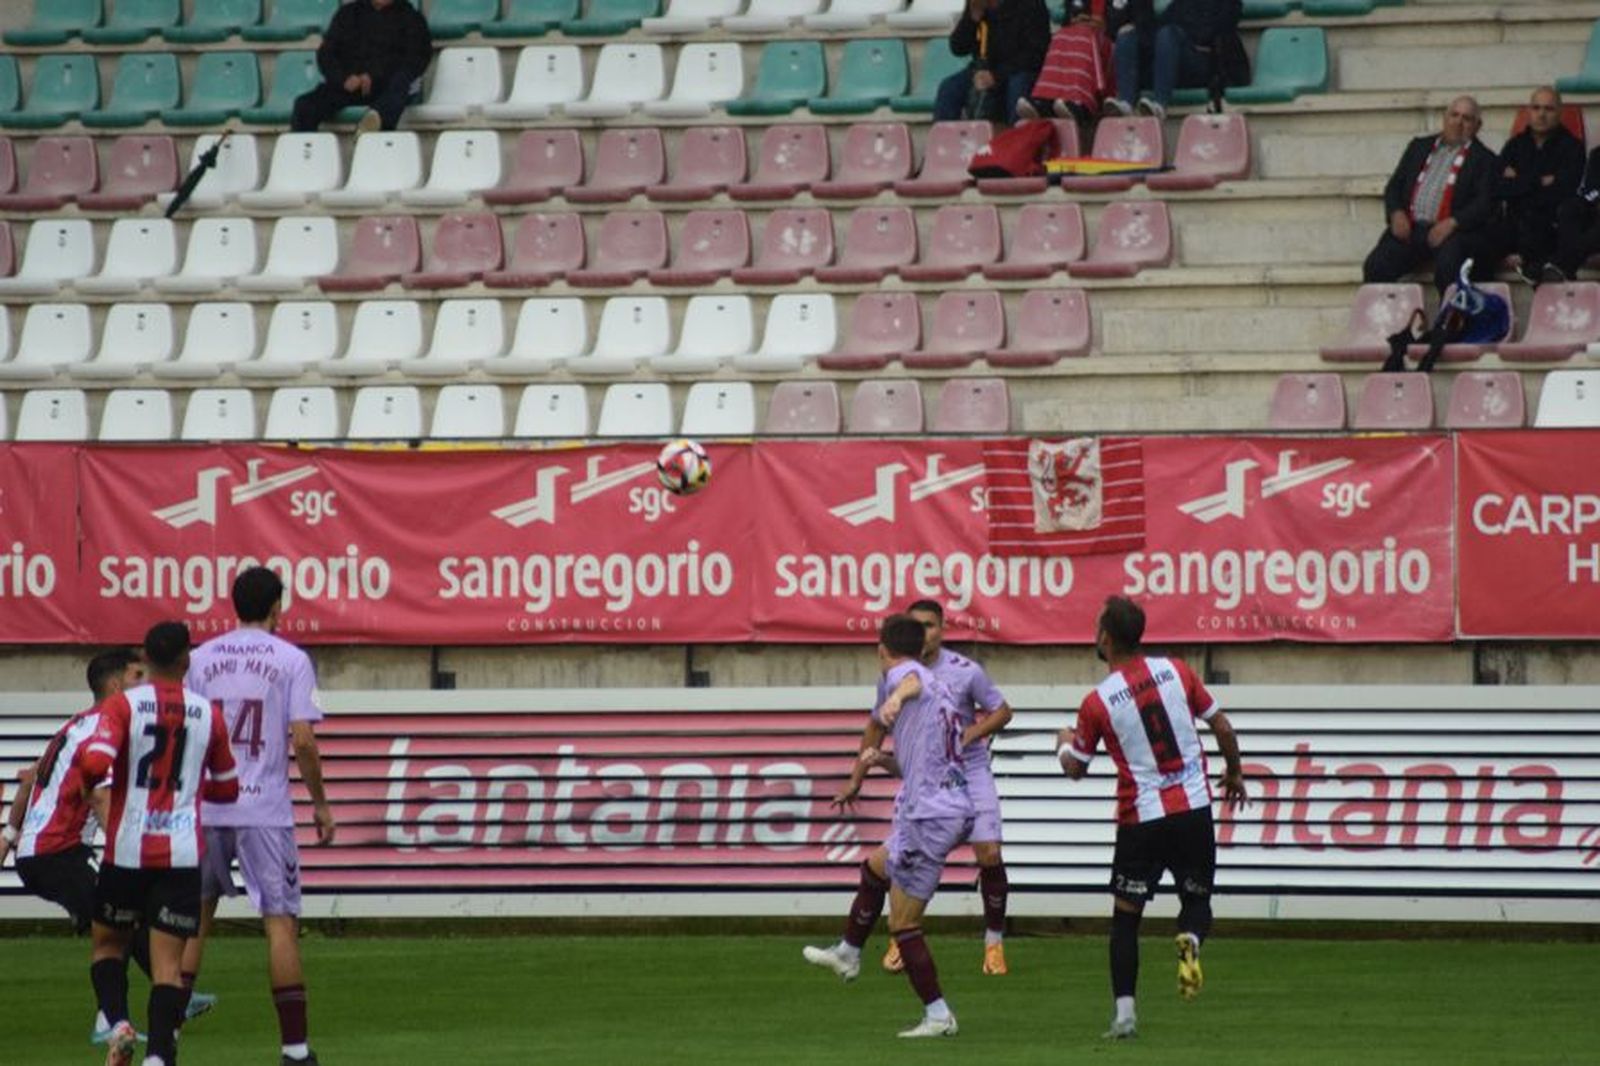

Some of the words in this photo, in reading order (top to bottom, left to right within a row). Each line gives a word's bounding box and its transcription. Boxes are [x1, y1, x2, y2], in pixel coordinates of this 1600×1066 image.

[291, 489, 337, 525] sgc
[628, 486, 676, 522] sgc
[1321, 481, 1373, 518] sgc
[1471, 492, 1600, 536] CARP
[99, 543, 391, 613] sangrgorio
[438, 539, 733, 613] sangregorio
[774, 551, 1074, 611] sangregorio
[1122, 537, 1431, 610] sangregorio
[507, 616, 662, 632] CONSTRUCCION
[1197, 615, 1358, 630] CONSTRUCCION
[203, 658, 238, 683] SAMU
[244, 657, 280, 684] MAYO
[216, 643, 275, 656] ABANCA
[135, 723, 189, 792] 21
[1141, 702, 1184, 763] 9
[385, 737, 815, 855] lantania
[1217, 742, 1564, 855] ntania
